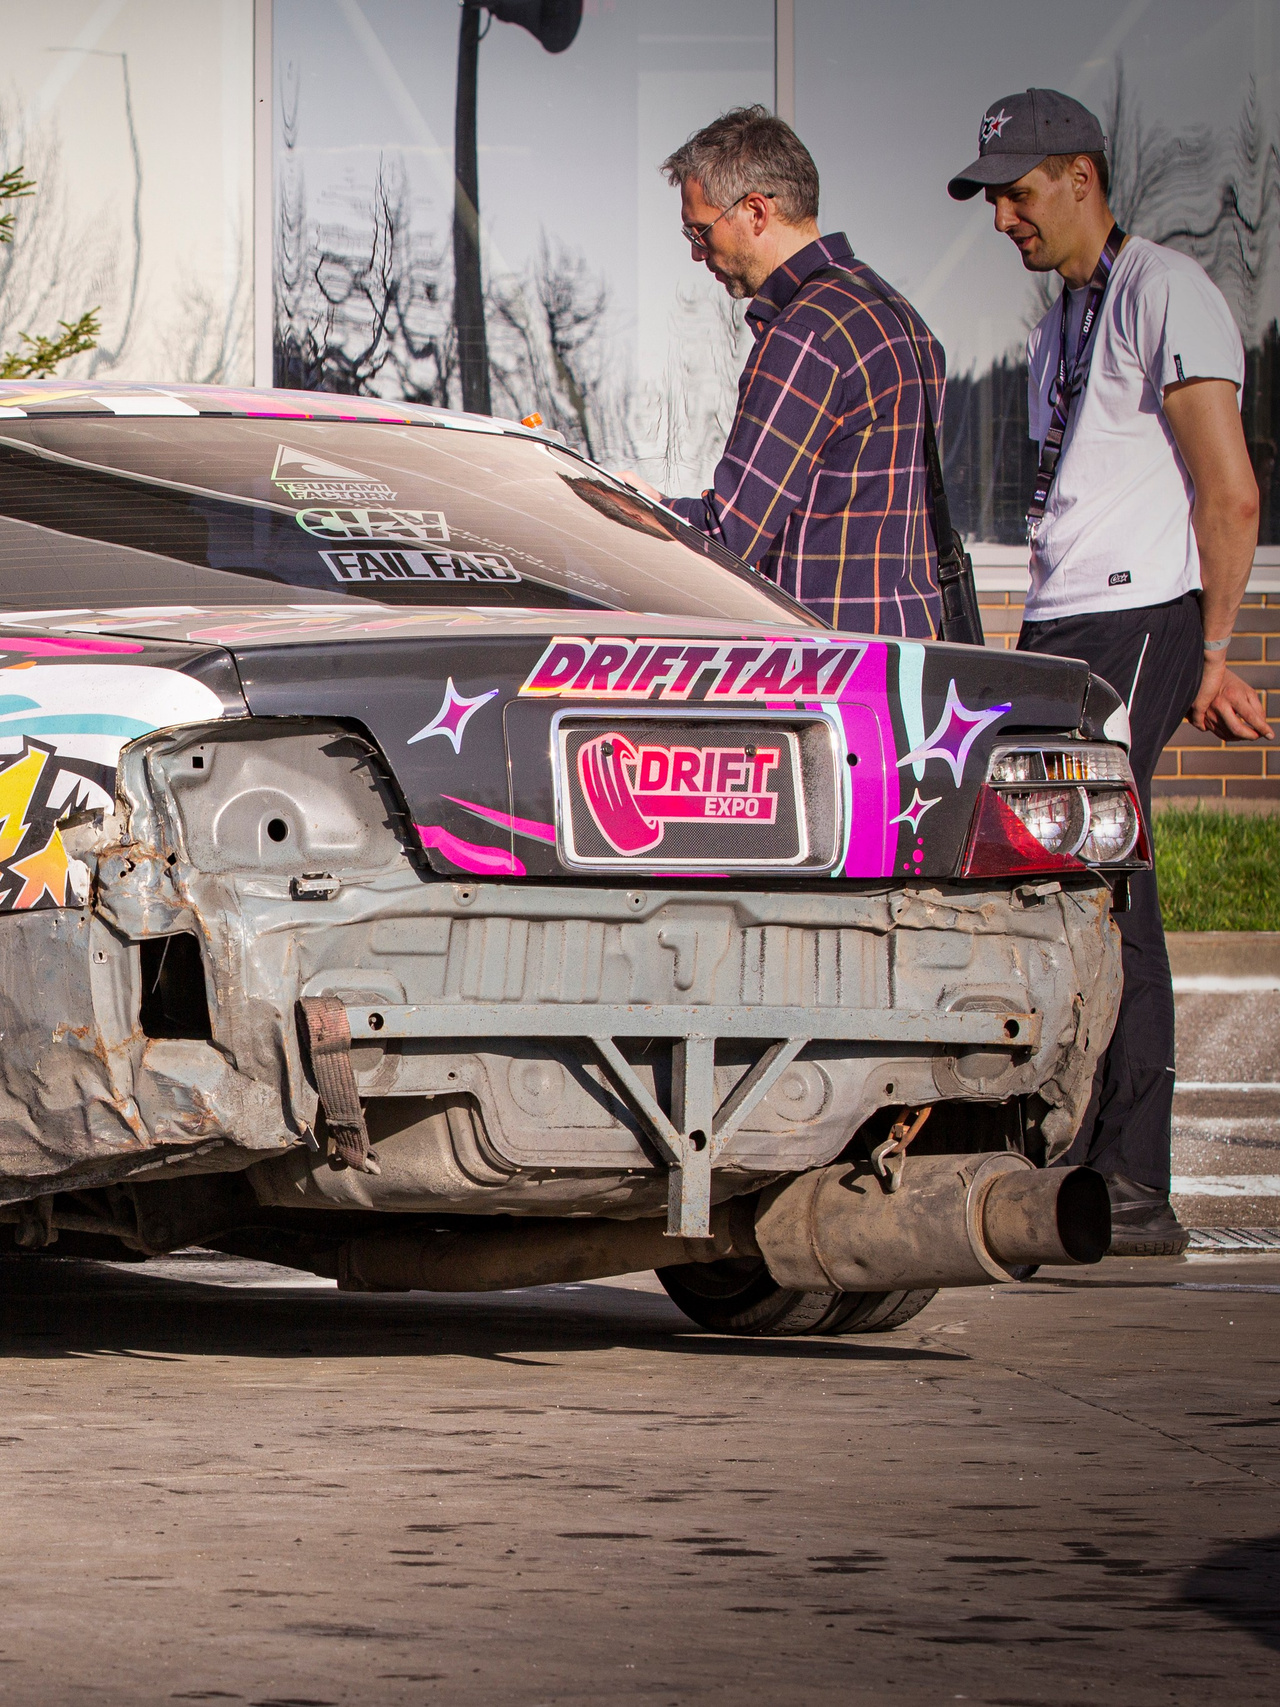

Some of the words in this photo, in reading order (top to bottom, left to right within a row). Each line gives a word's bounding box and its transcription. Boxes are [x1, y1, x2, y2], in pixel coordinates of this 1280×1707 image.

[1083, 308, 1094, 334] AUTO
[279, 483, 391, 492] TSUNAMI
[291, 491, 396, 500] FACTORY
[525, 643, 720, 693] DRIFT
[714, 646, 860, 695] TAXI
[638, 751, 774, 793] DRIFT
[703, 797, 760, 817] EXPO
